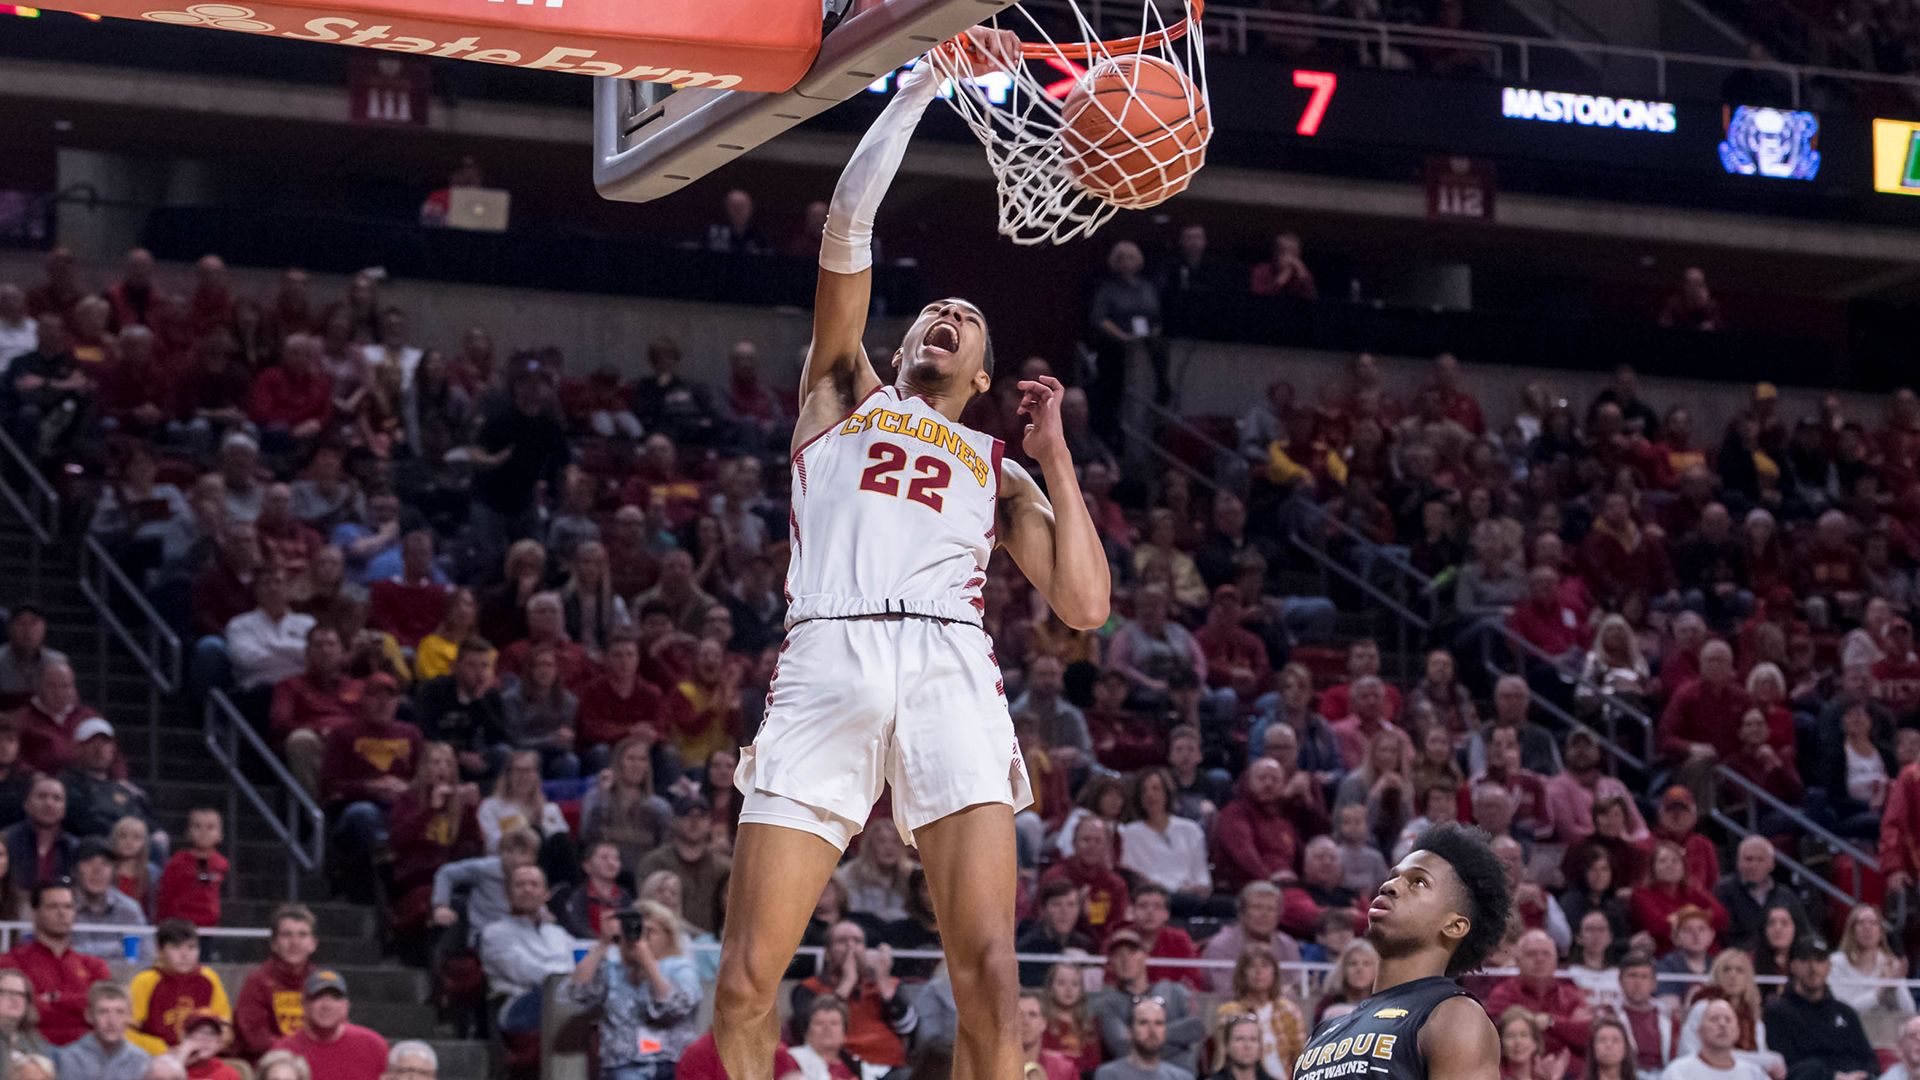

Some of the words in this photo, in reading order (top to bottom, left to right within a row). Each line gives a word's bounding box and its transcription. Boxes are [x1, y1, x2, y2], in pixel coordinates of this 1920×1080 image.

[366, 88, 411, 122] 111
[1292, 69, 1337, 136] 7
[1502, 86, 1676, 133] MASTODONS
[1438, 185, 1482, 217] 112
[839, 407, 990, 488] CYCLONES
[859, 441, 953, 514] 22
[1324, 1060, 1369, 1079] WAYNE
